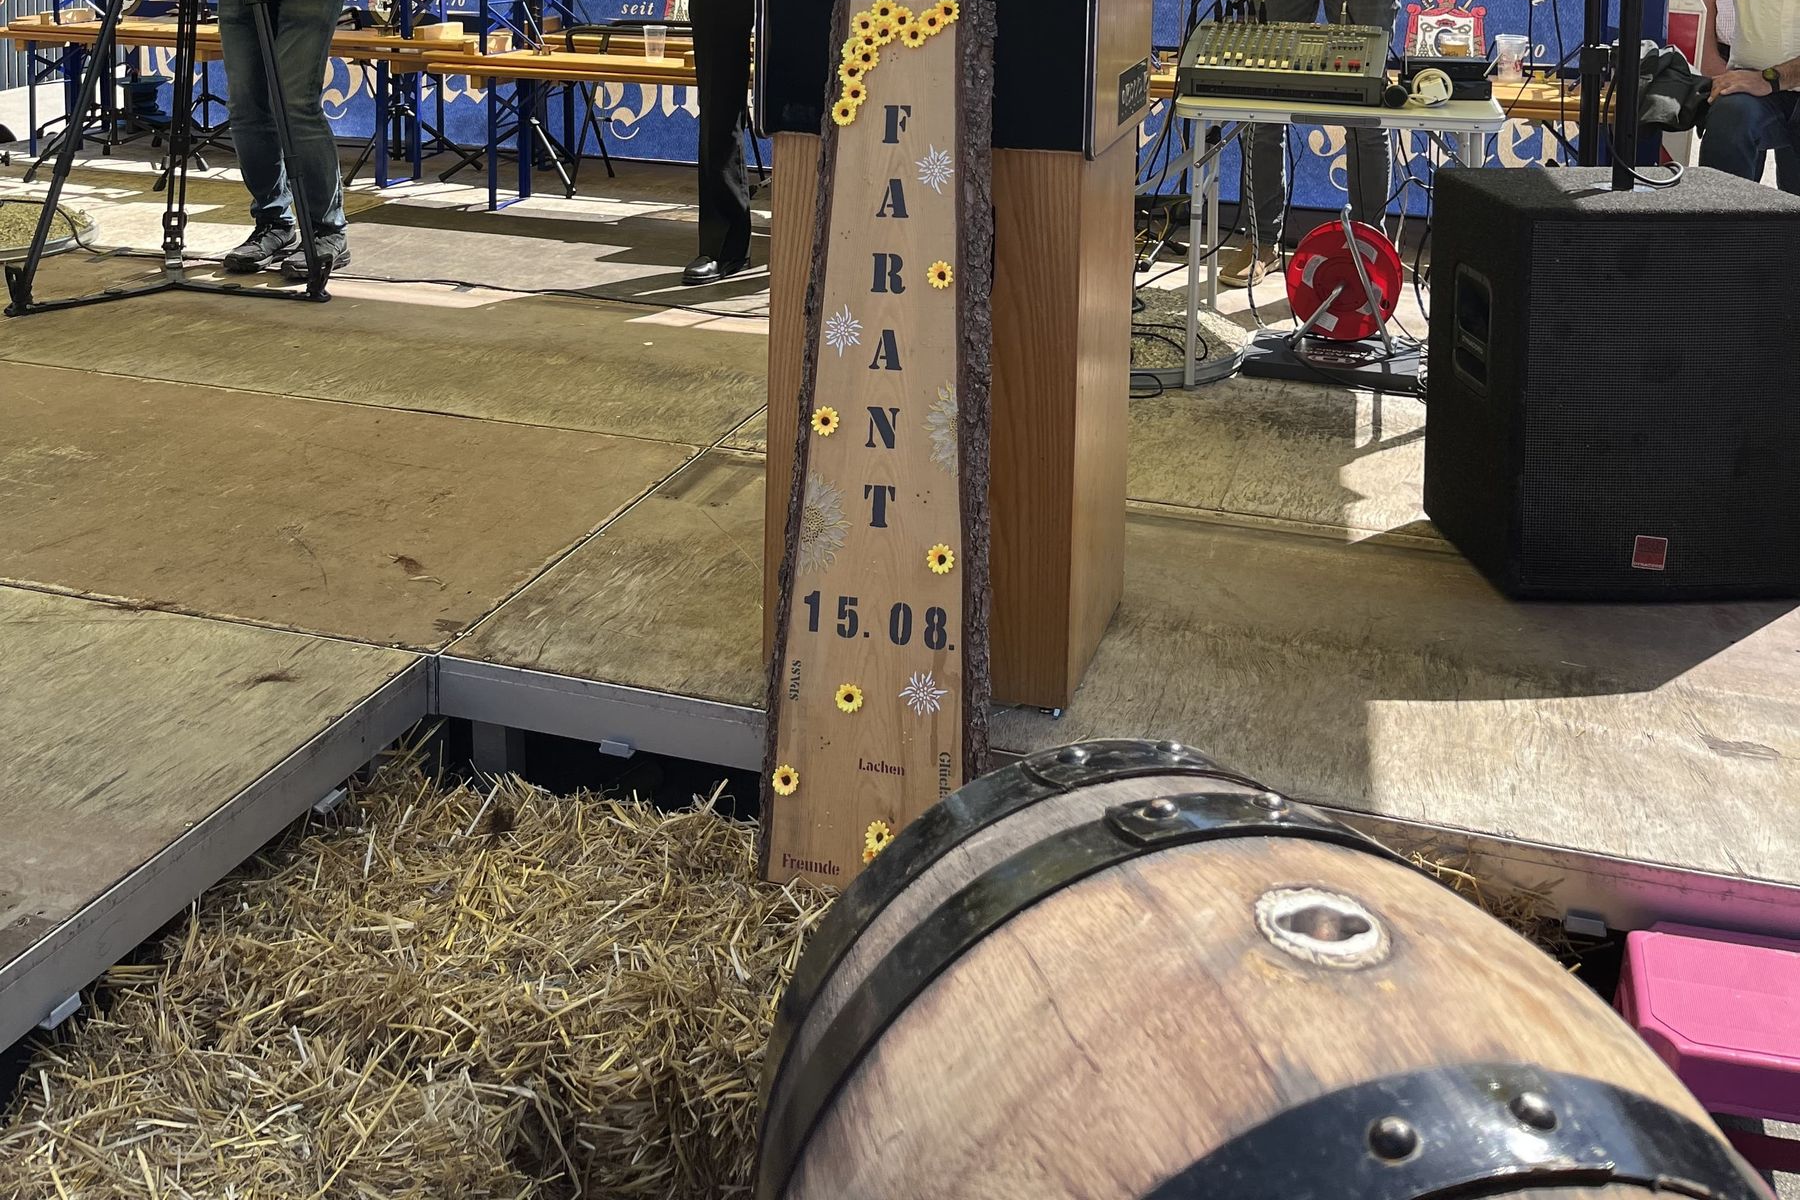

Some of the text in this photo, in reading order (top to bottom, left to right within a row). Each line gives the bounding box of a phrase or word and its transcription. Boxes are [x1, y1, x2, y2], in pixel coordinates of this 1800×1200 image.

[621, 1, 655, 16] seit
[863, 104, 912, 529] FARANT
[788, 659, 802, 701] SPASS
[858, 757, 905, 777] Lachen
[782, 853, 840, 876] Freunde
